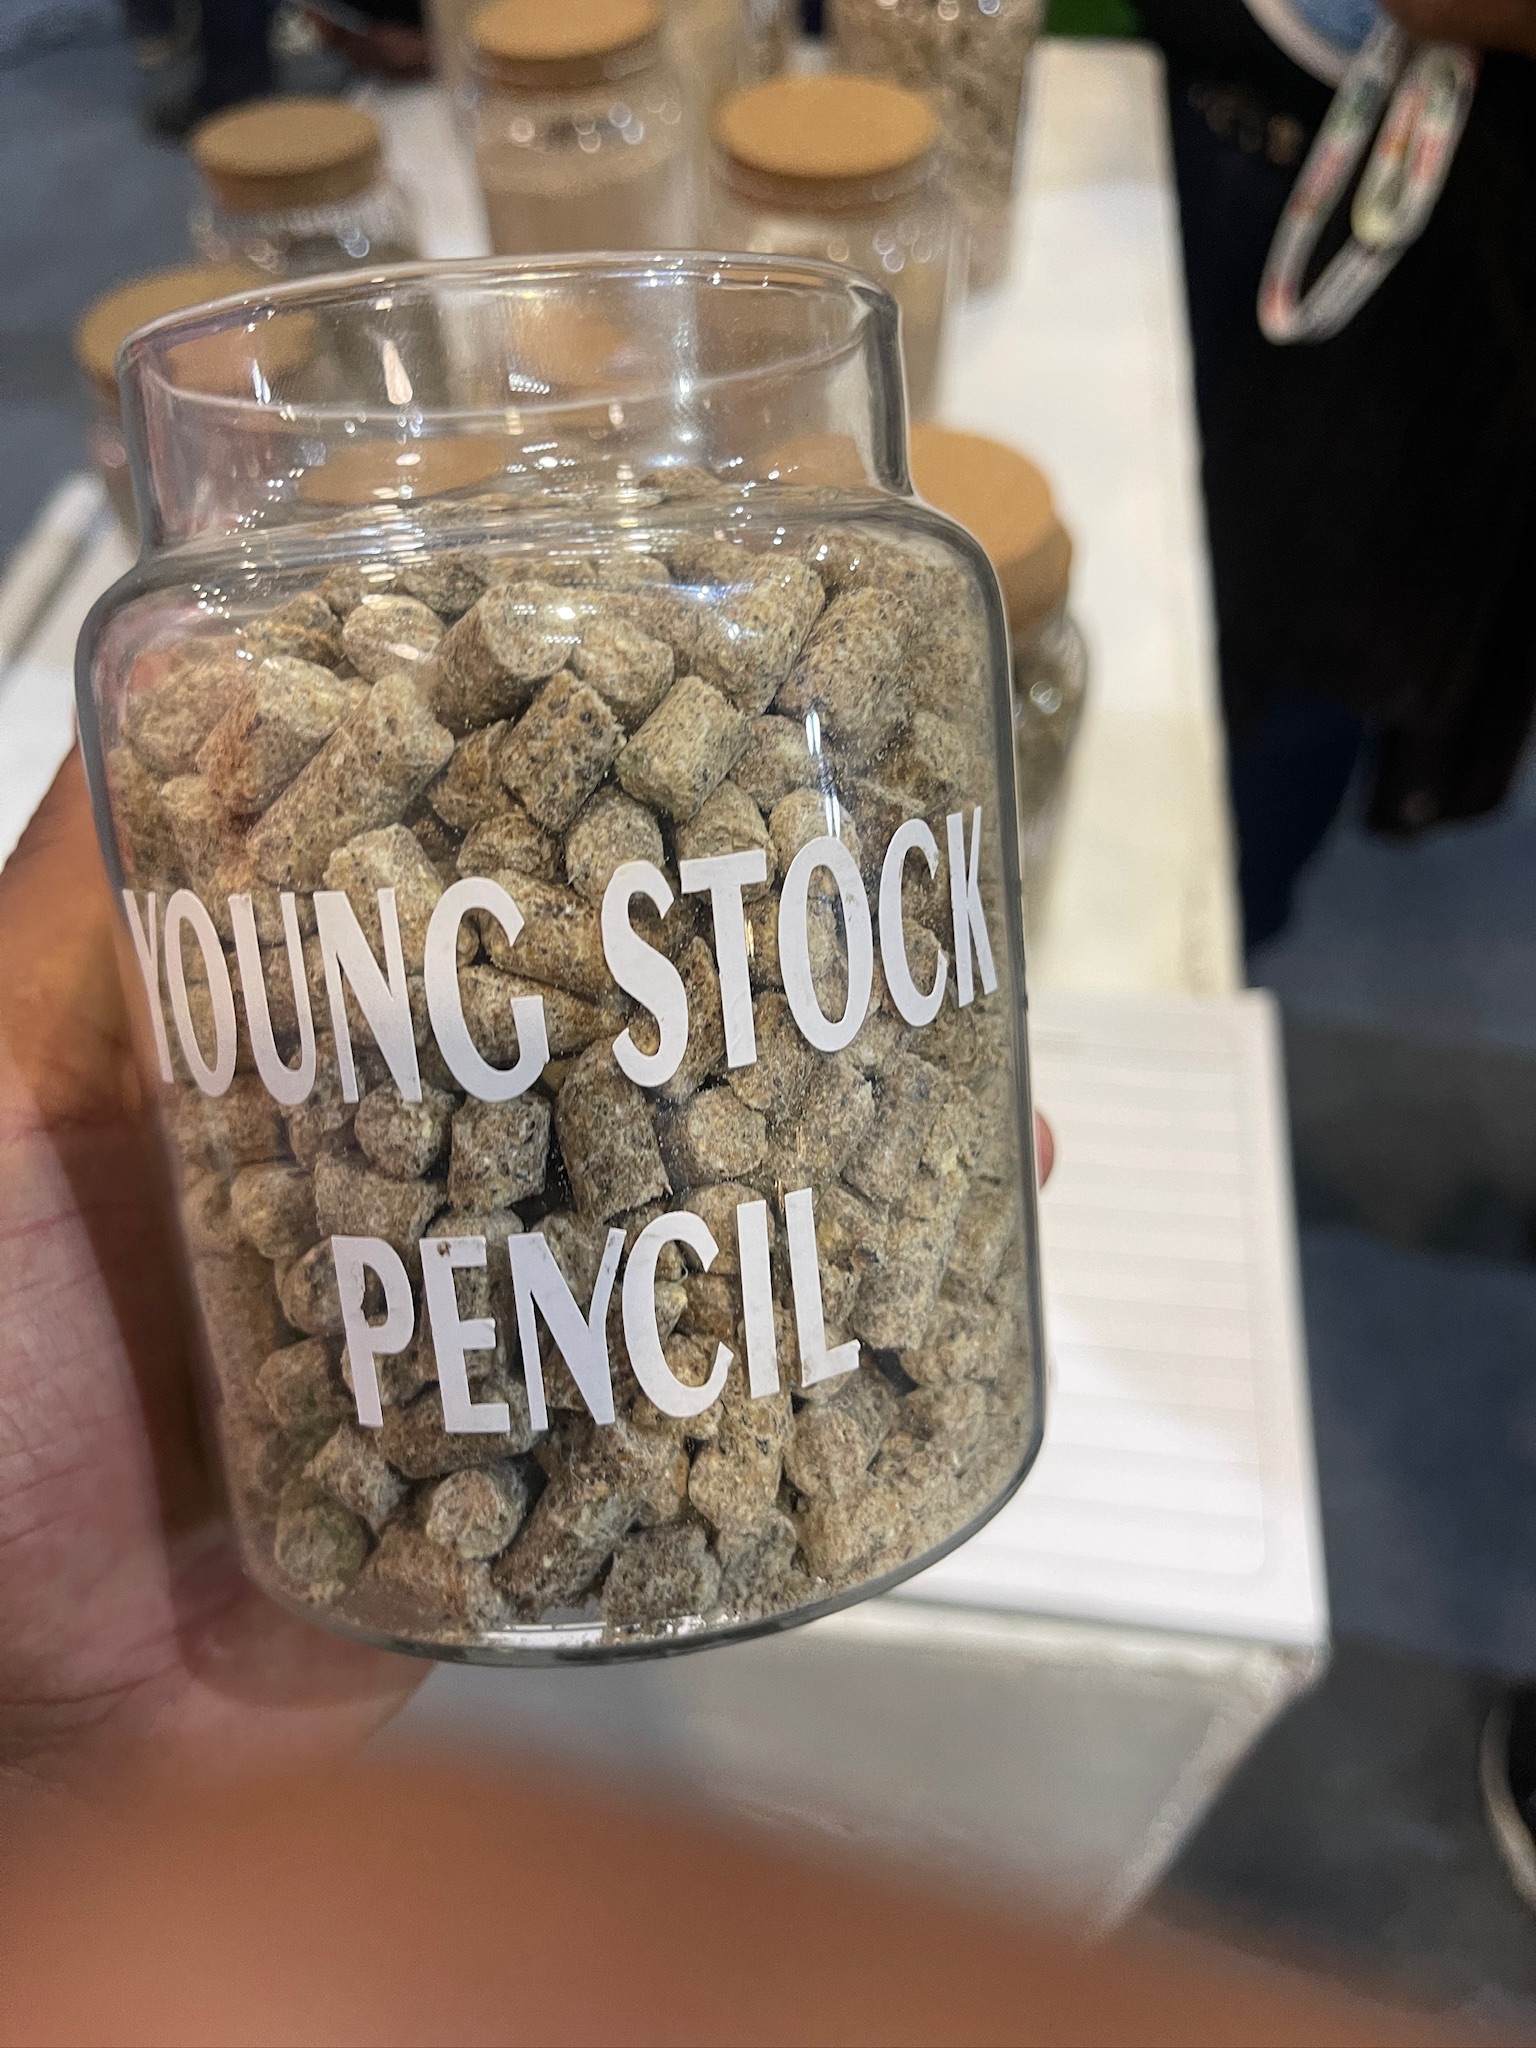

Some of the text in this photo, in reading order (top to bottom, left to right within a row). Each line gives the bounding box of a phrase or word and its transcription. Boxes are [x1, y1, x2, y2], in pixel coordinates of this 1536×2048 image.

[122, 806, 998, 1105] YOUNG STOCK
[331, 1187, 860, 1433] PENCIL
